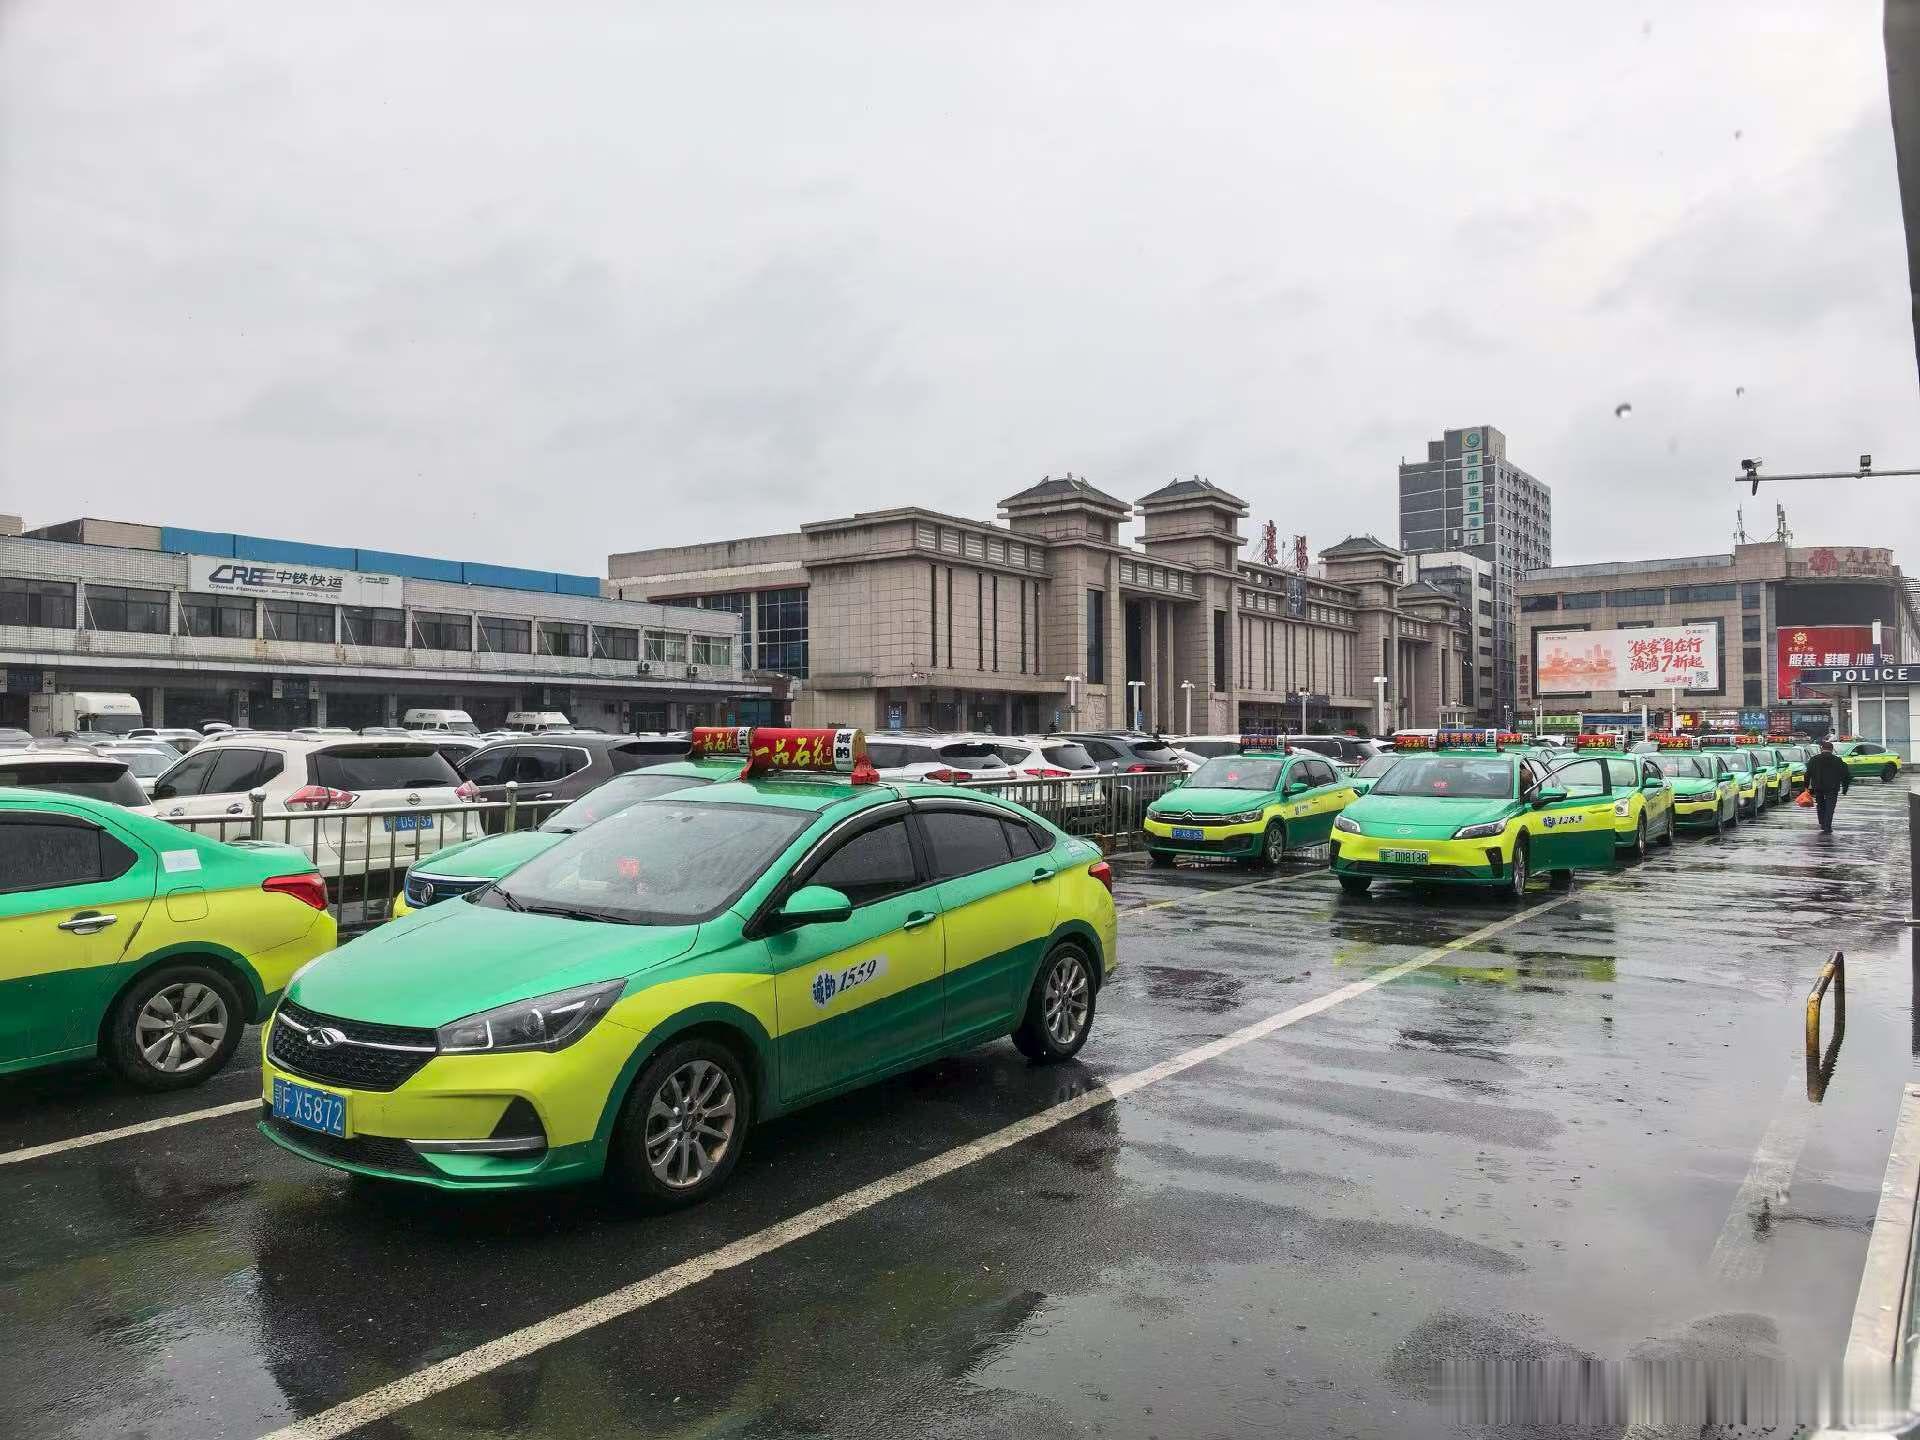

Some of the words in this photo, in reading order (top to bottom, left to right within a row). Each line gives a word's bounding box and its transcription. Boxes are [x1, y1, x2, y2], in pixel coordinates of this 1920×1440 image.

[276, 570, 343, 589] 中铁快运
[1630, 655, 1705, 674] 滴滴7折起
[1832, 668, 1908, 682] POLICE
[838, 959, 877, 993] 1559
